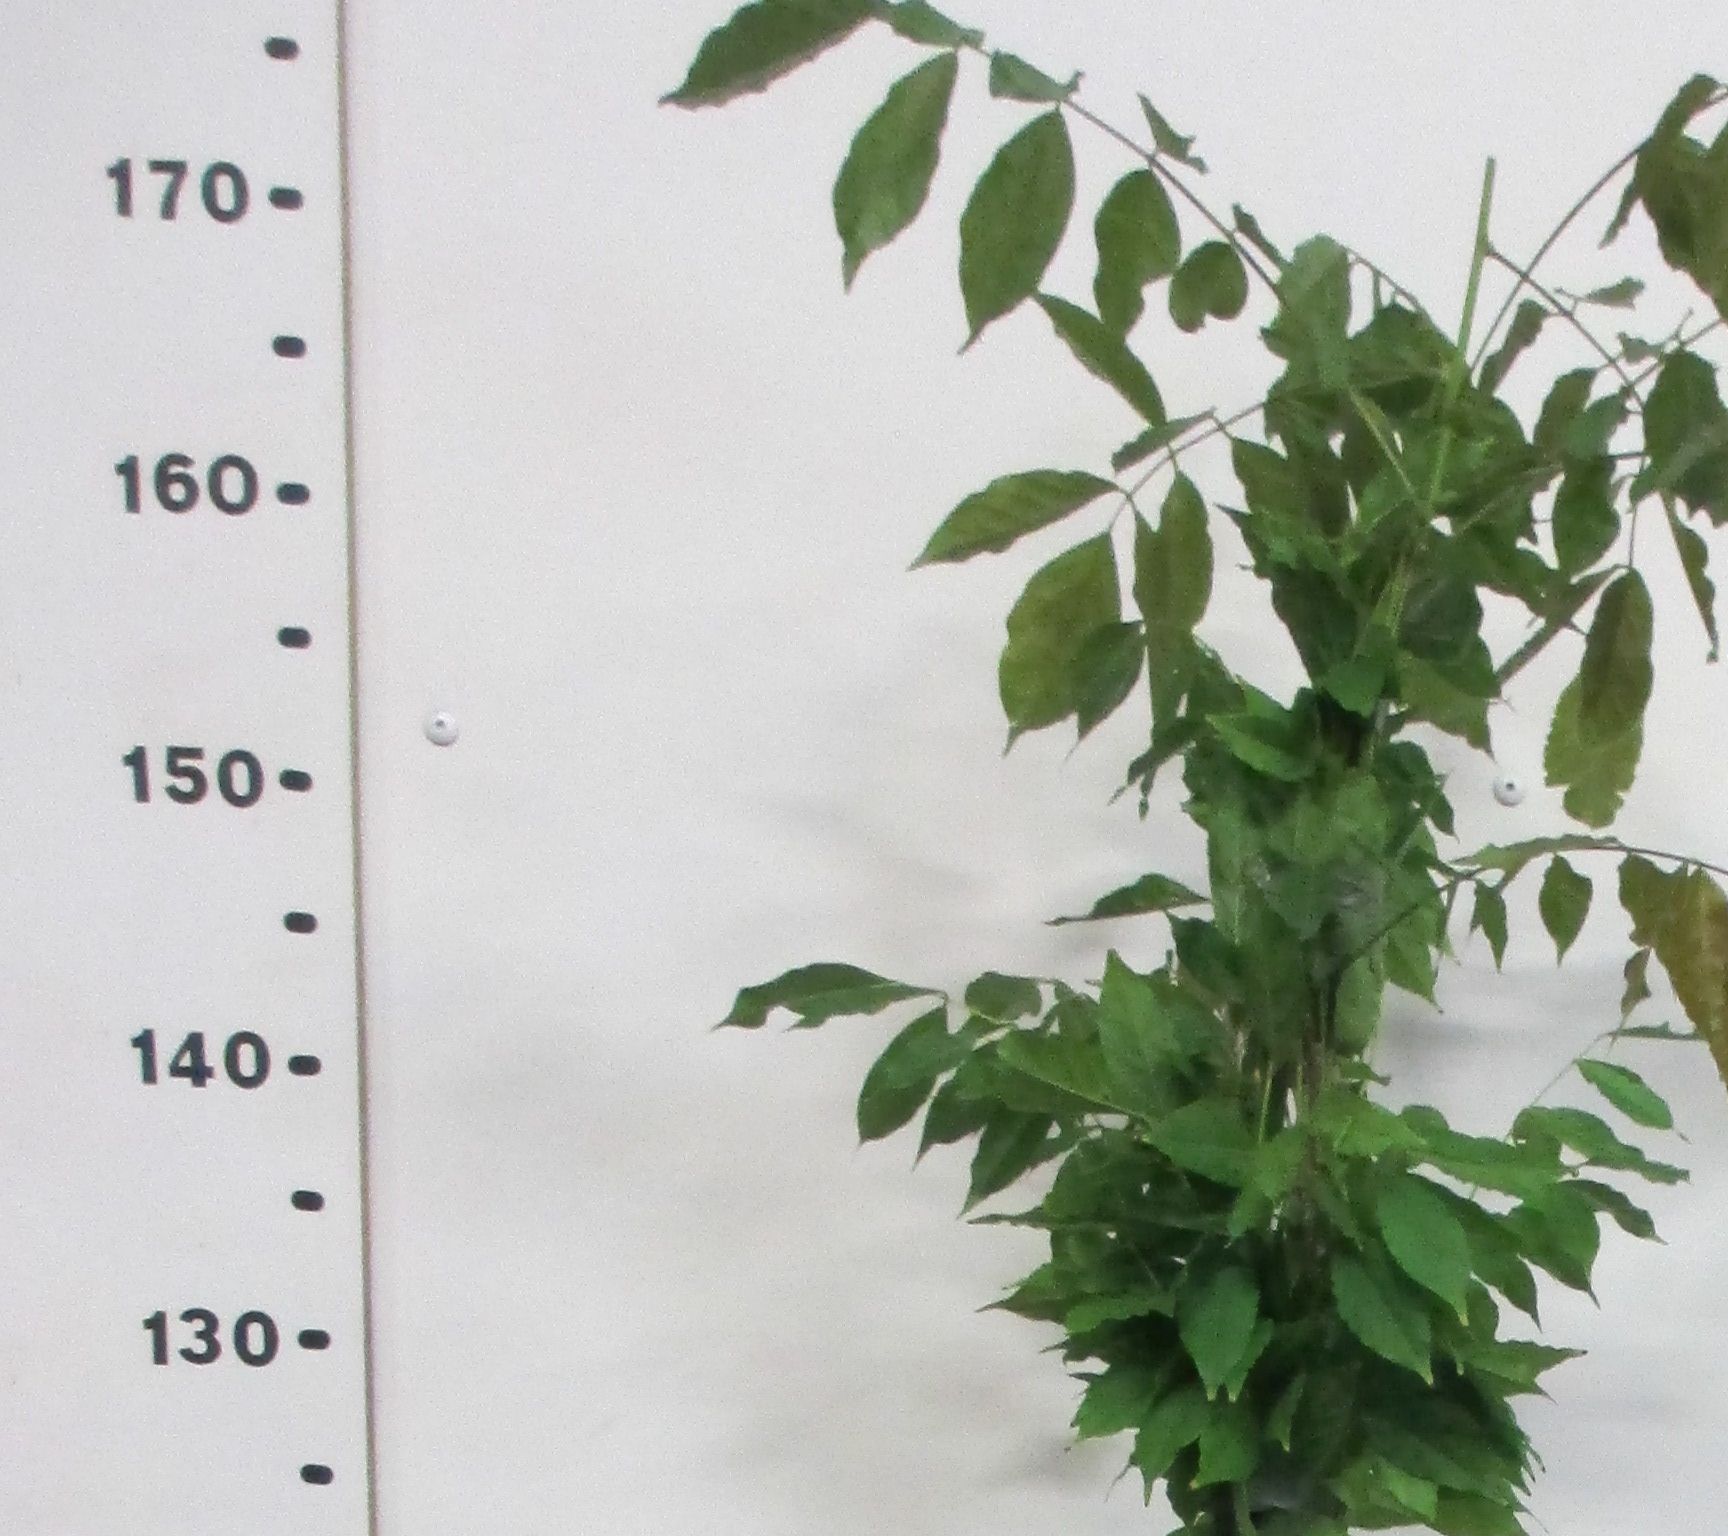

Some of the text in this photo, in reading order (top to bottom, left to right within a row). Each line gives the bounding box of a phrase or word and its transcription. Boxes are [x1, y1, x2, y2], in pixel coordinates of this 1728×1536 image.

[106, 158, 249, 224] 170
[114, 452, 258, 516] 160
[121, 745, 264, 809] 150
[129, 1028, 271, 1090] 140
[141, 1307, 279, 1368] 130
